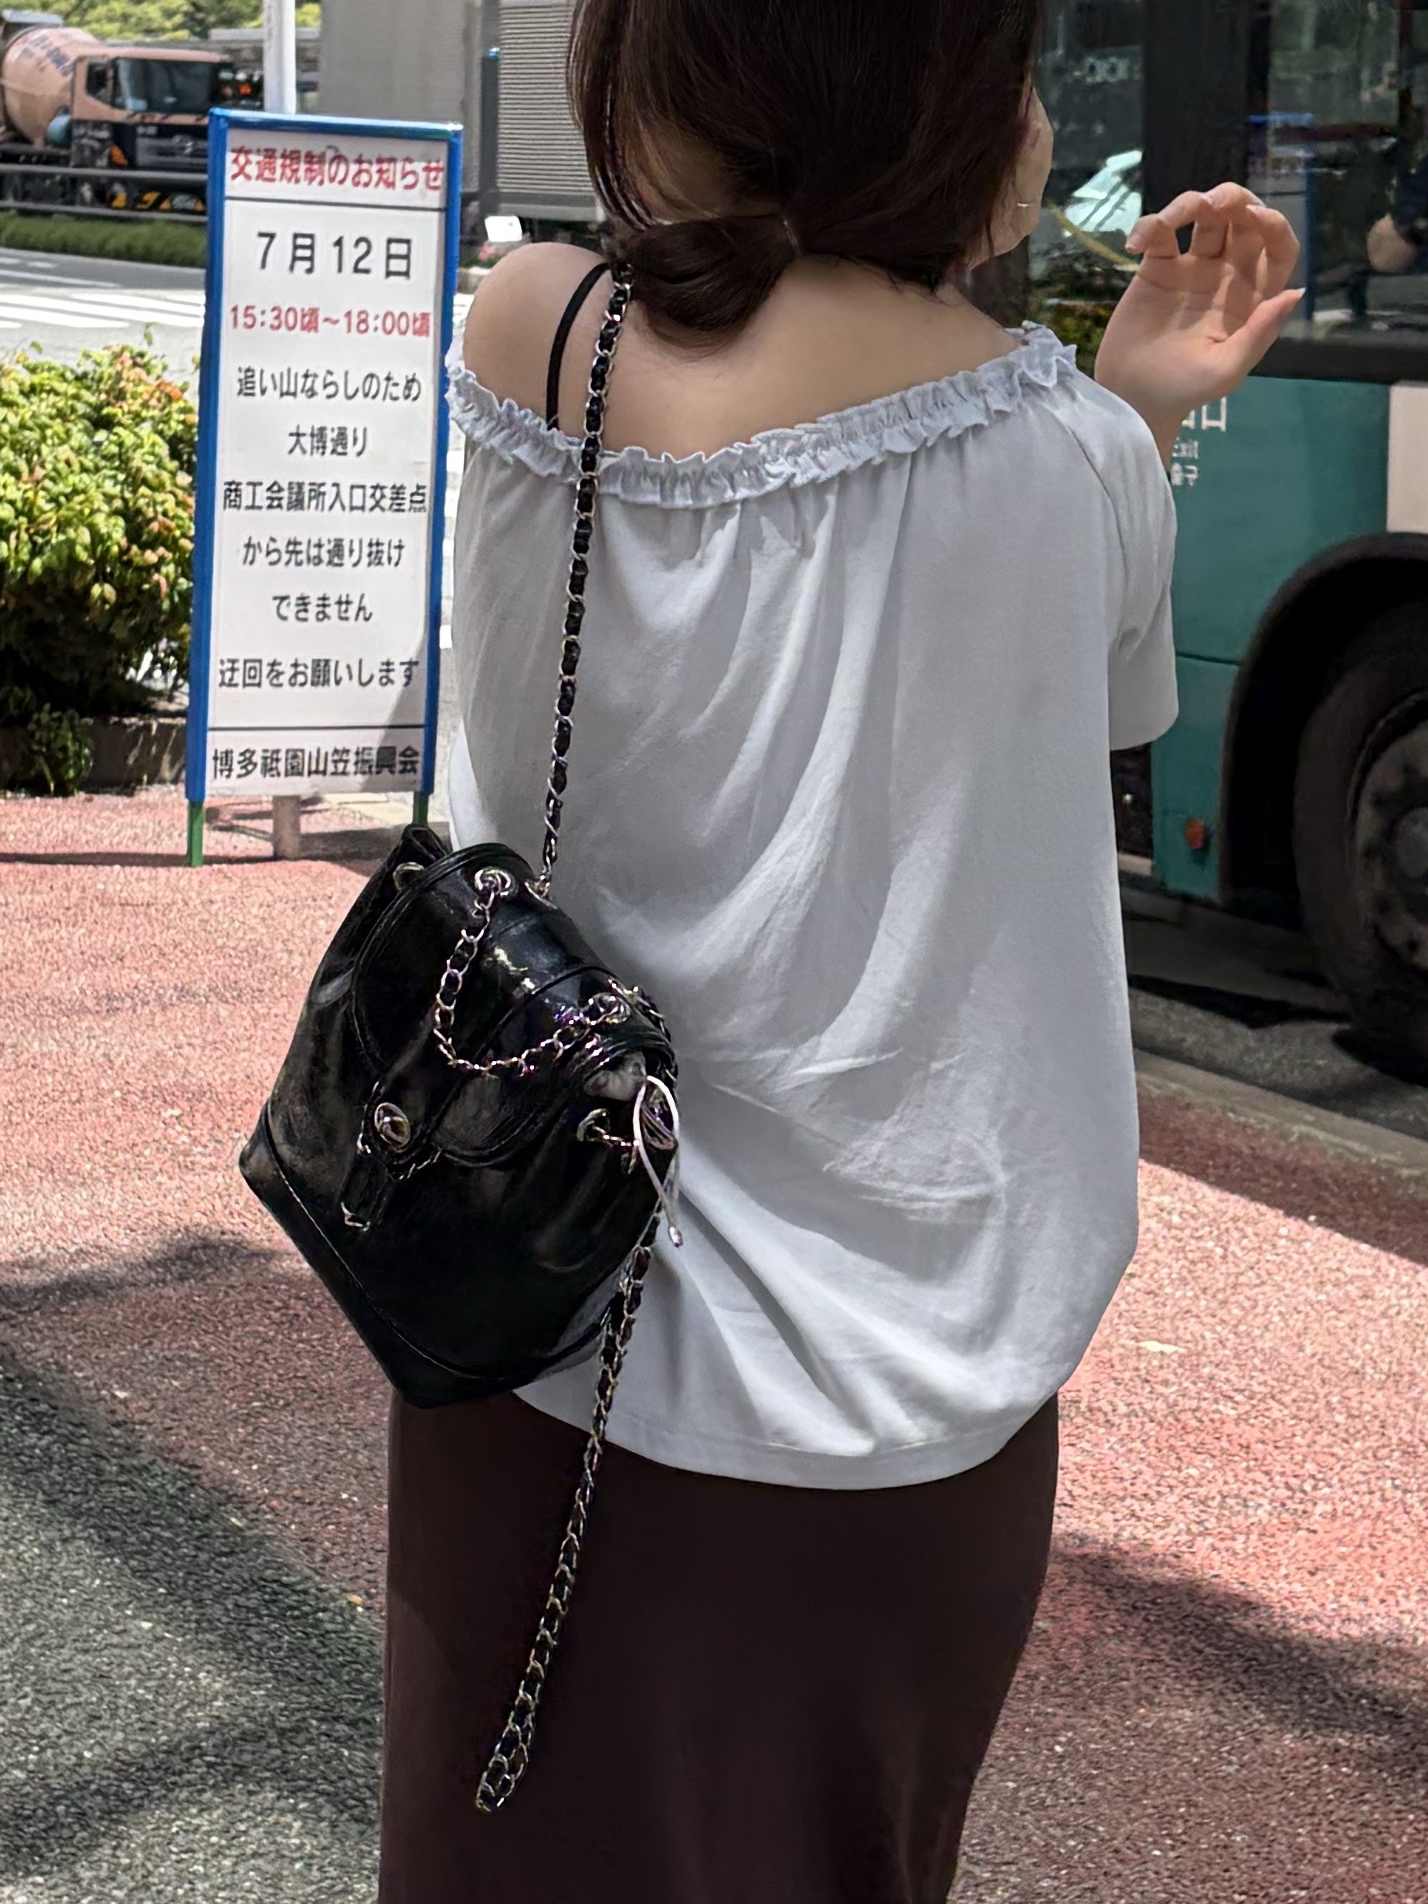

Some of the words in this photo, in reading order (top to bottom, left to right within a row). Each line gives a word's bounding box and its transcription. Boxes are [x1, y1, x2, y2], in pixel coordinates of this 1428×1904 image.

[230, 146, 445, 191] 交通規制のお知らせ
[256, 231, 412, 280] 7月12日
[237, 365, 422, 402] 追い山ならしのため
[287, 423, 368, 457] 大博通り
[222, 479, 428, 513] 商工会議所入口交差点
[242, 535, 406, 568] から先は通り抜け
[271, 592, 374, 623] できません
[218, 657, 420, 689] 迂回をお願いします
[212, 745, 421, 780] 博多祇園山笠振興会
